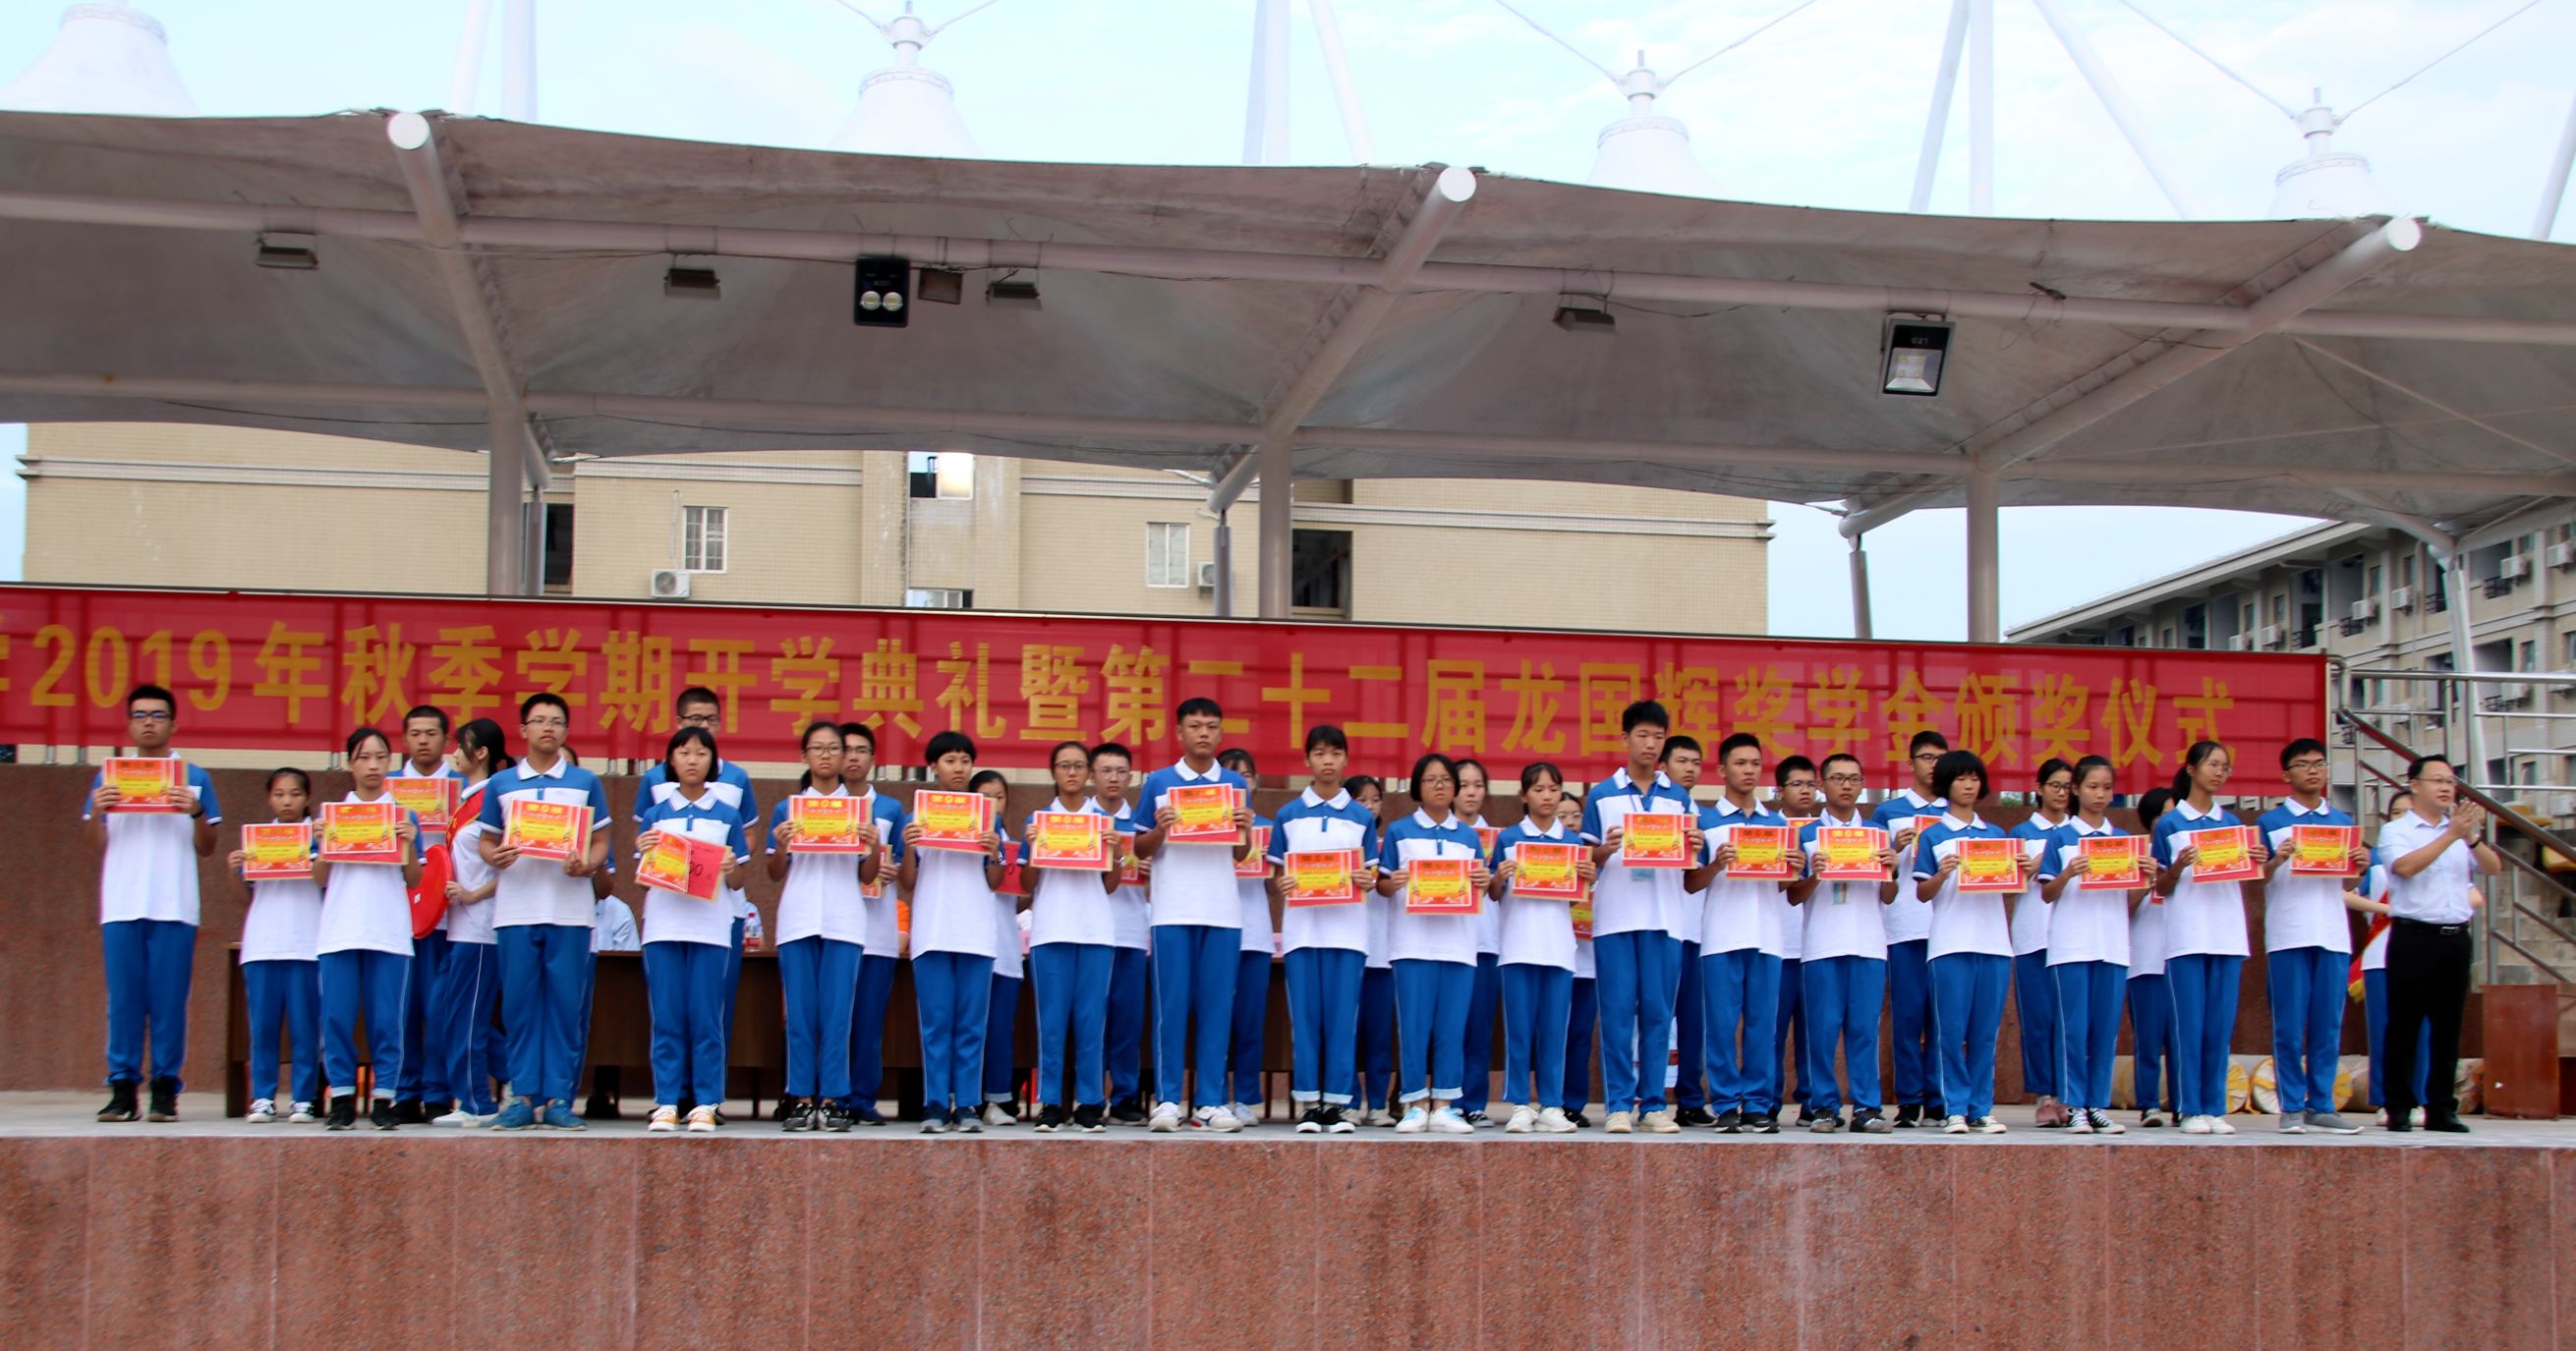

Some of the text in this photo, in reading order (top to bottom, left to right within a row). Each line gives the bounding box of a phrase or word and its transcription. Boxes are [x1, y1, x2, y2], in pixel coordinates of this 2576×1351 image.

[0, 613, 2236, 769] 2019年秋季学期开学典礼暨第二十二届龙国辉奖学金颁奖仪式
